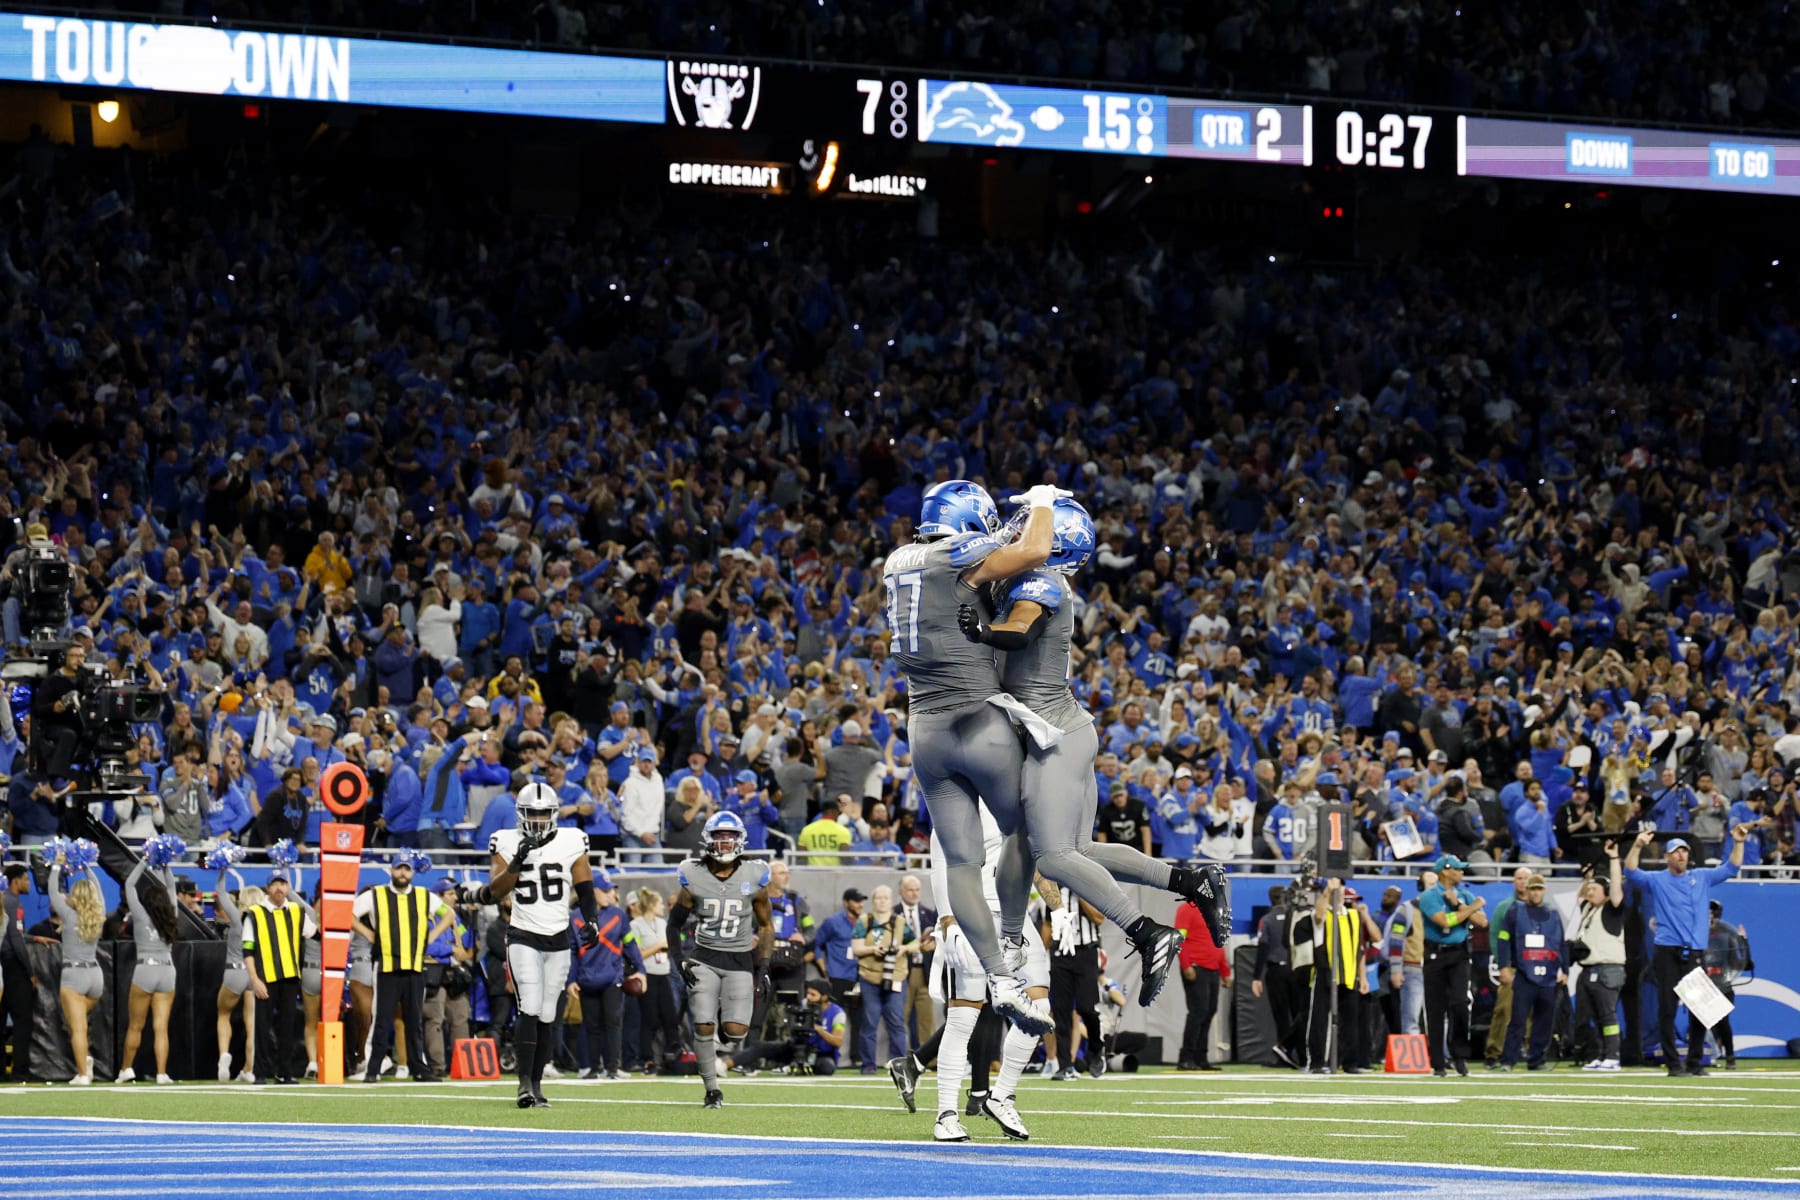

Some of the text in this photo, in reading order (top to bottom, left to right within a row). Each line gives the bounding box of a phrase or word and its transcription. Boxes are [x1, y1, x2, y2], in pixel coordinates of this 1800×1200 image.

[22, 16, 350, 101] TOUCOWN
[680, 61, 748, 78] RAIDERS
[857, 79, 883, 134] 7
[1082, 95, 1131, 149] 15
[1202, 108, 1282, 160] QTR 2
[1336, 111, 1432, 168] 0:27
[1571, 138, 1628, 168] DOWN
[1715, 148, 1769, 177] TO GO
[669, 163, 780, 187] COPPERCRAFT
[811, 834, 837, 849] 105
[1278, 818, 1307, 843] 20
[1328, 811, 1343, 850] 1
[515, 863, 563, 904] 56
[700, 898, 743, 938] 26
[462, 1041, 495, 1077] 10
[1394, 1036, 1426, 1070] 20
